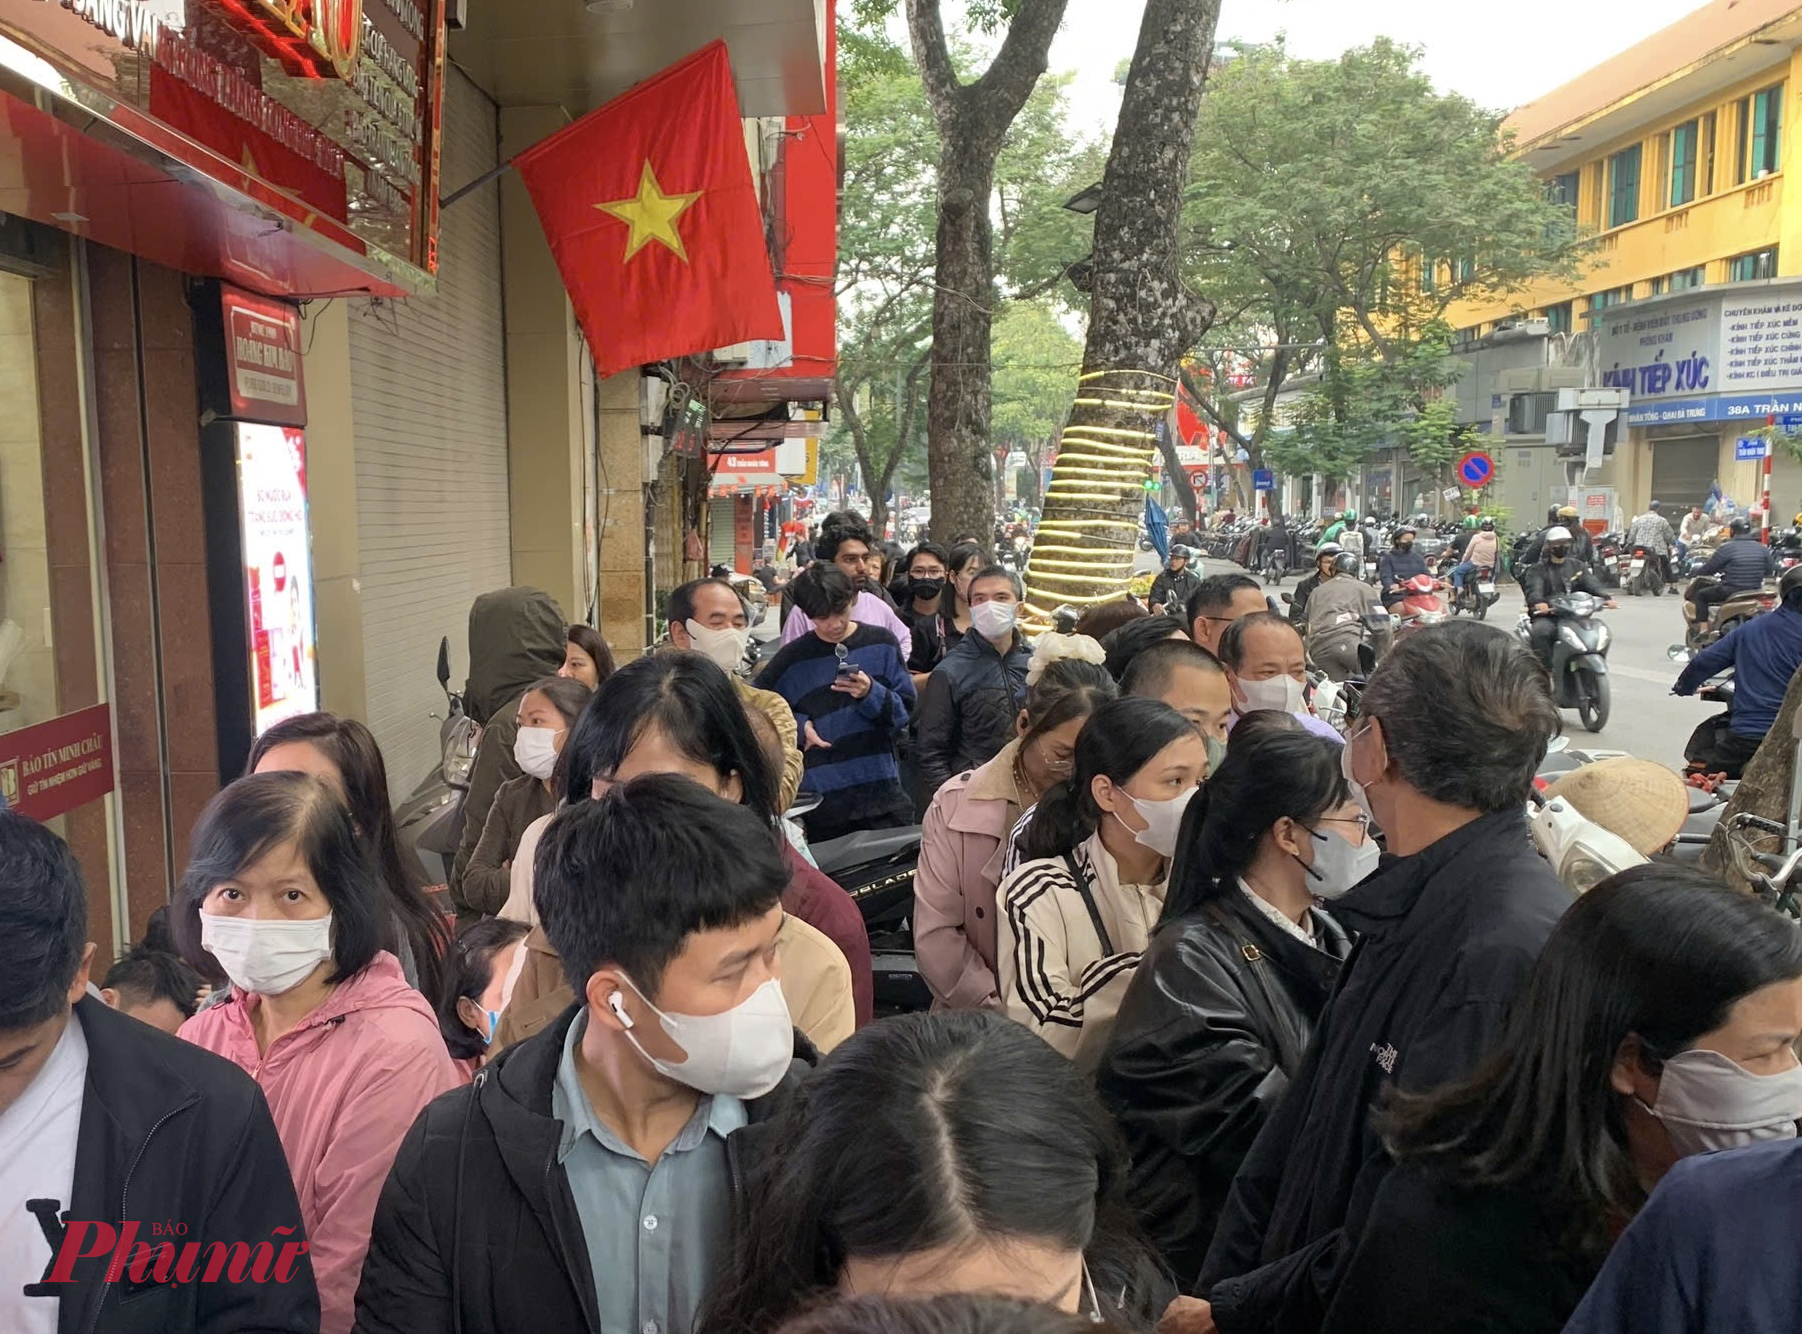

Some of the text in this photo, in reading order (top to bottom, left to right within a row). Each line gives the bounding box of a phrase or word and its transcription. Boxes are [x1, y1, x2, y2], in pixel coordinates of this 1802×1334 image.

[1638, 349, 1672, 395] TIẾP
[1675, 350, 1709, 391] XÚC
[1727, 405, 1750, 415] 38A
[1753, 398, 1789, 414] TRẦN
[58, 742, 81, 764] MINH
